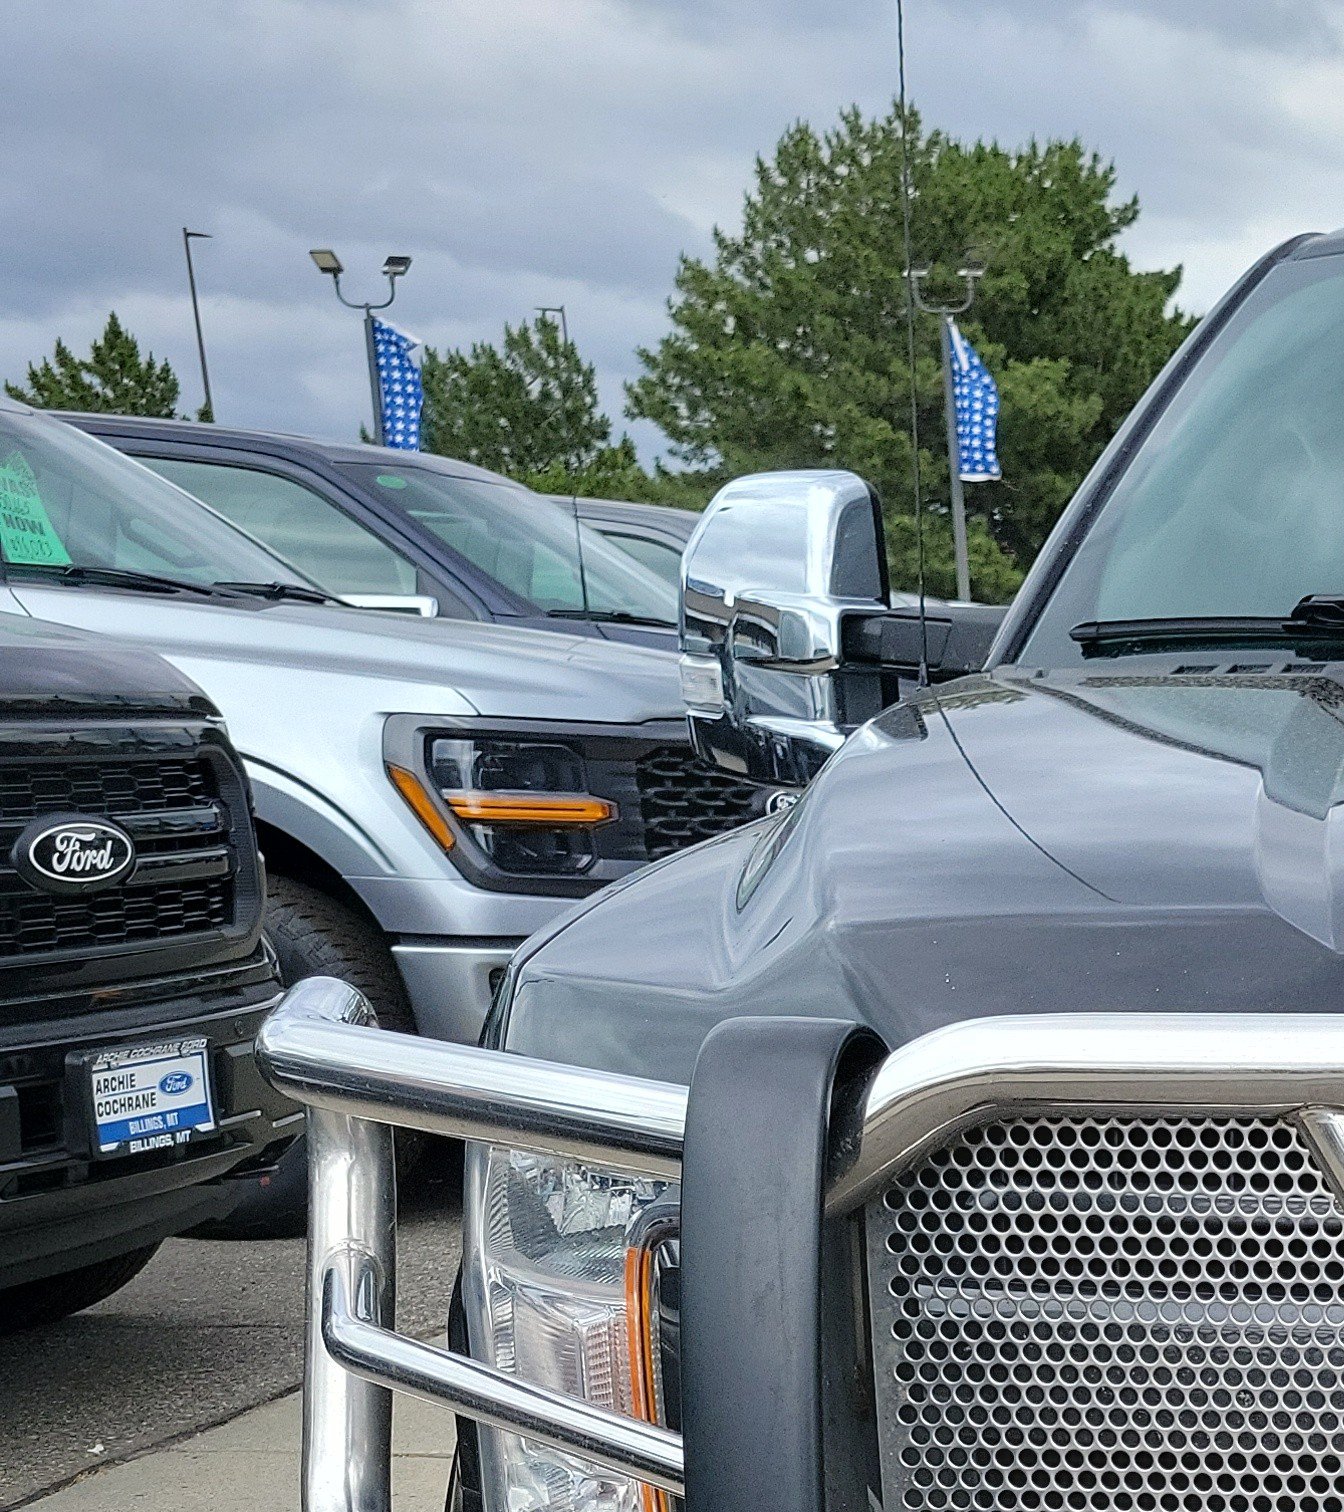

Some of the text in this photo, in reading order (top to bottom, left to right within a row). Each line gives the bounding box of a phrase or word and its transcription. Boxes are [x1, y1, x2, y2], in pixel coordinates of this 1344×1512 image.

[52, 830, 115, 873] Ford
[96, 1073, 136, 1095] ARCHIE
[166, 1075, 187, 1092] Ford
[96, 1092, 157, 1118] COCHRANE
[128, 1112, 179, 1135] BILLINGS, MT
[129, 1130, 192, 1153] BILLINGS, MT
